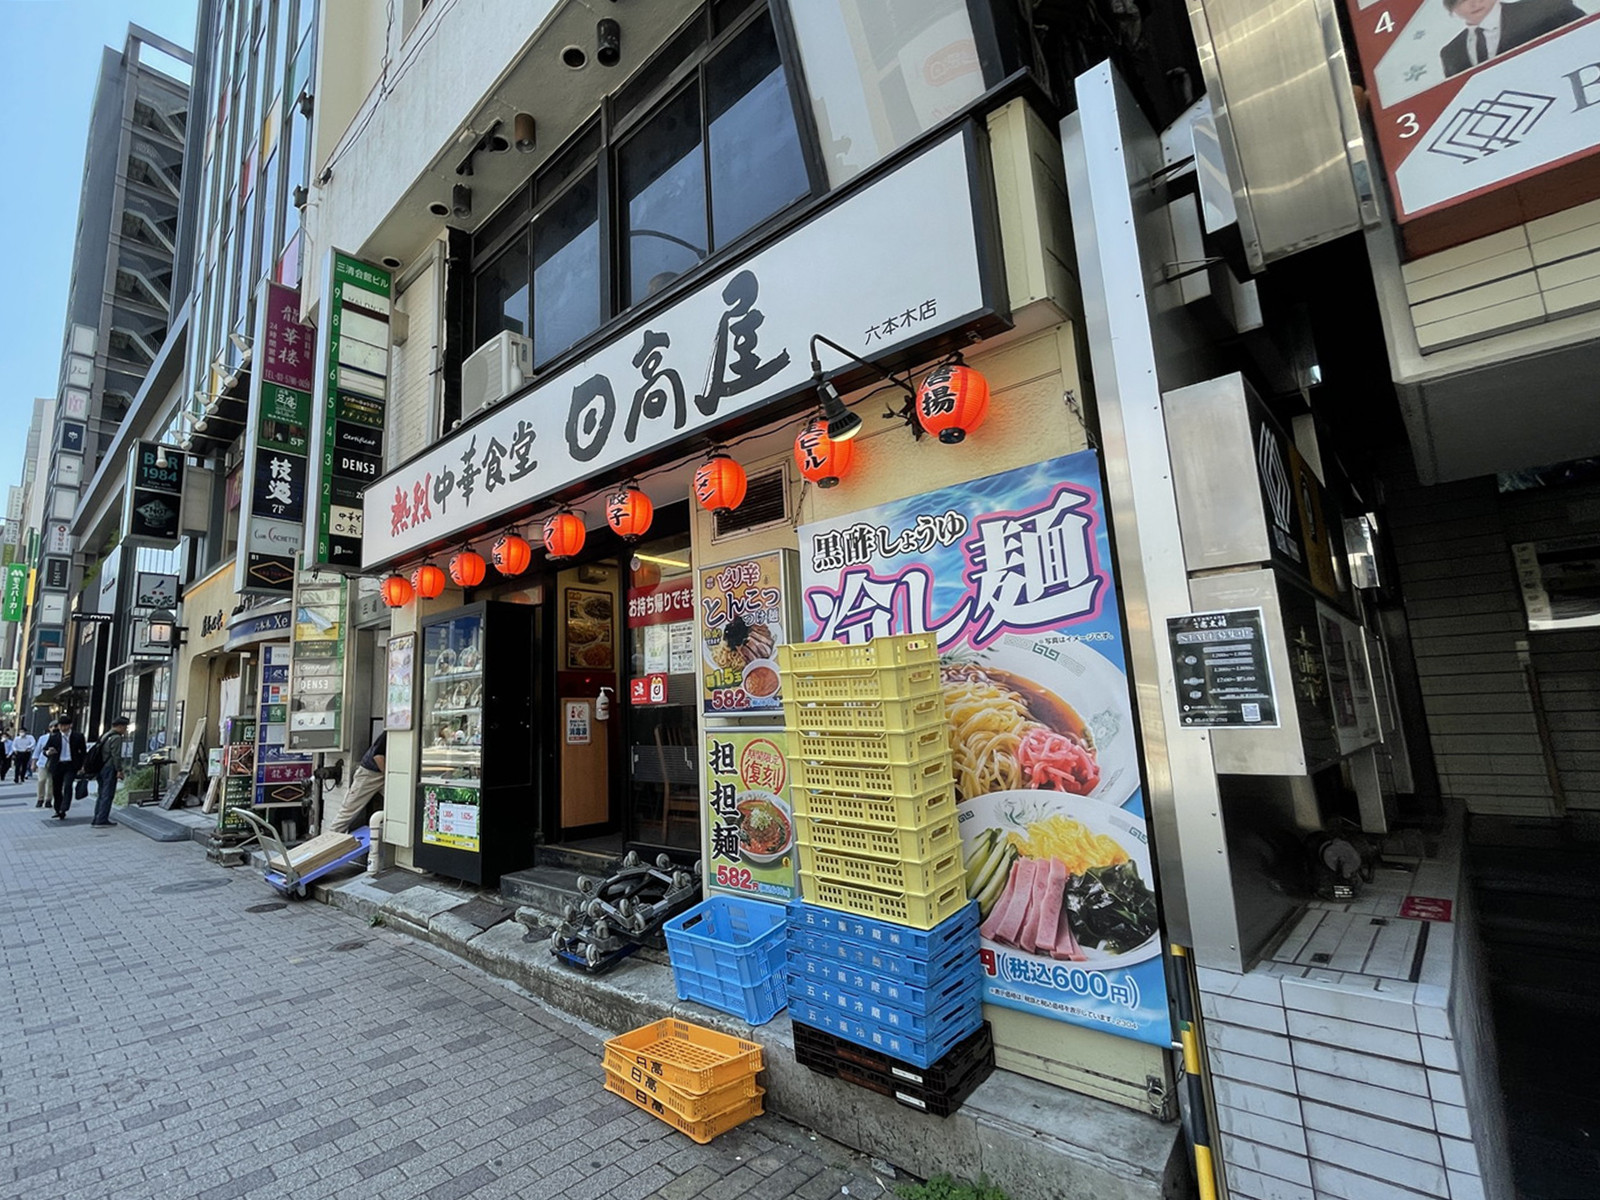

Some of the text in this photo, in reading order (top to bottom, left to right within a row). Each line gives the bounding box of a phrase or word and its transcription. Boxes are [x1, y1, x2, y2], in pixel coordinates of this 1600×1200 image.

[1374, 11, 1396, 34] 4
[1396, 112, 1420, 138] 3
[334, 287, 341, 298] 9
[333, 315, 339, 326] 8
[864, 298, 937, 345] 六本木店
[331, 342, 338, 353] 7
[330, 369, 336, 380] 6
[565, 269, 791, 462] 日高屋
[328, 397, 335, 408] 5
[326, 426, 332, 436] 4
[143, 451, 178, 470] BR
[325, 453, 331, 466] 3
[142, 466, 177, 482] 1984
[323, 483, 329, 495] 2
[271, 504, 285, 514] 7F
[608, 492, 630, 526] 餃子
[811, 510, 967, 572] 黒酢しょうゆ
[717, 562, 761, 592] ピリ辛
[804, 484, 1107, 647] 冷し麺
[702, 587, 781, 628] とんこつ
[744, 759, 780, 790] 復刻
[708, 740, 742, 863] 担担麺
[1001, 951, 1141, 1011] (税込600円)
[631, 1066, 657, 1093] 日高
[636, 1089, 664, 1115] 日高
